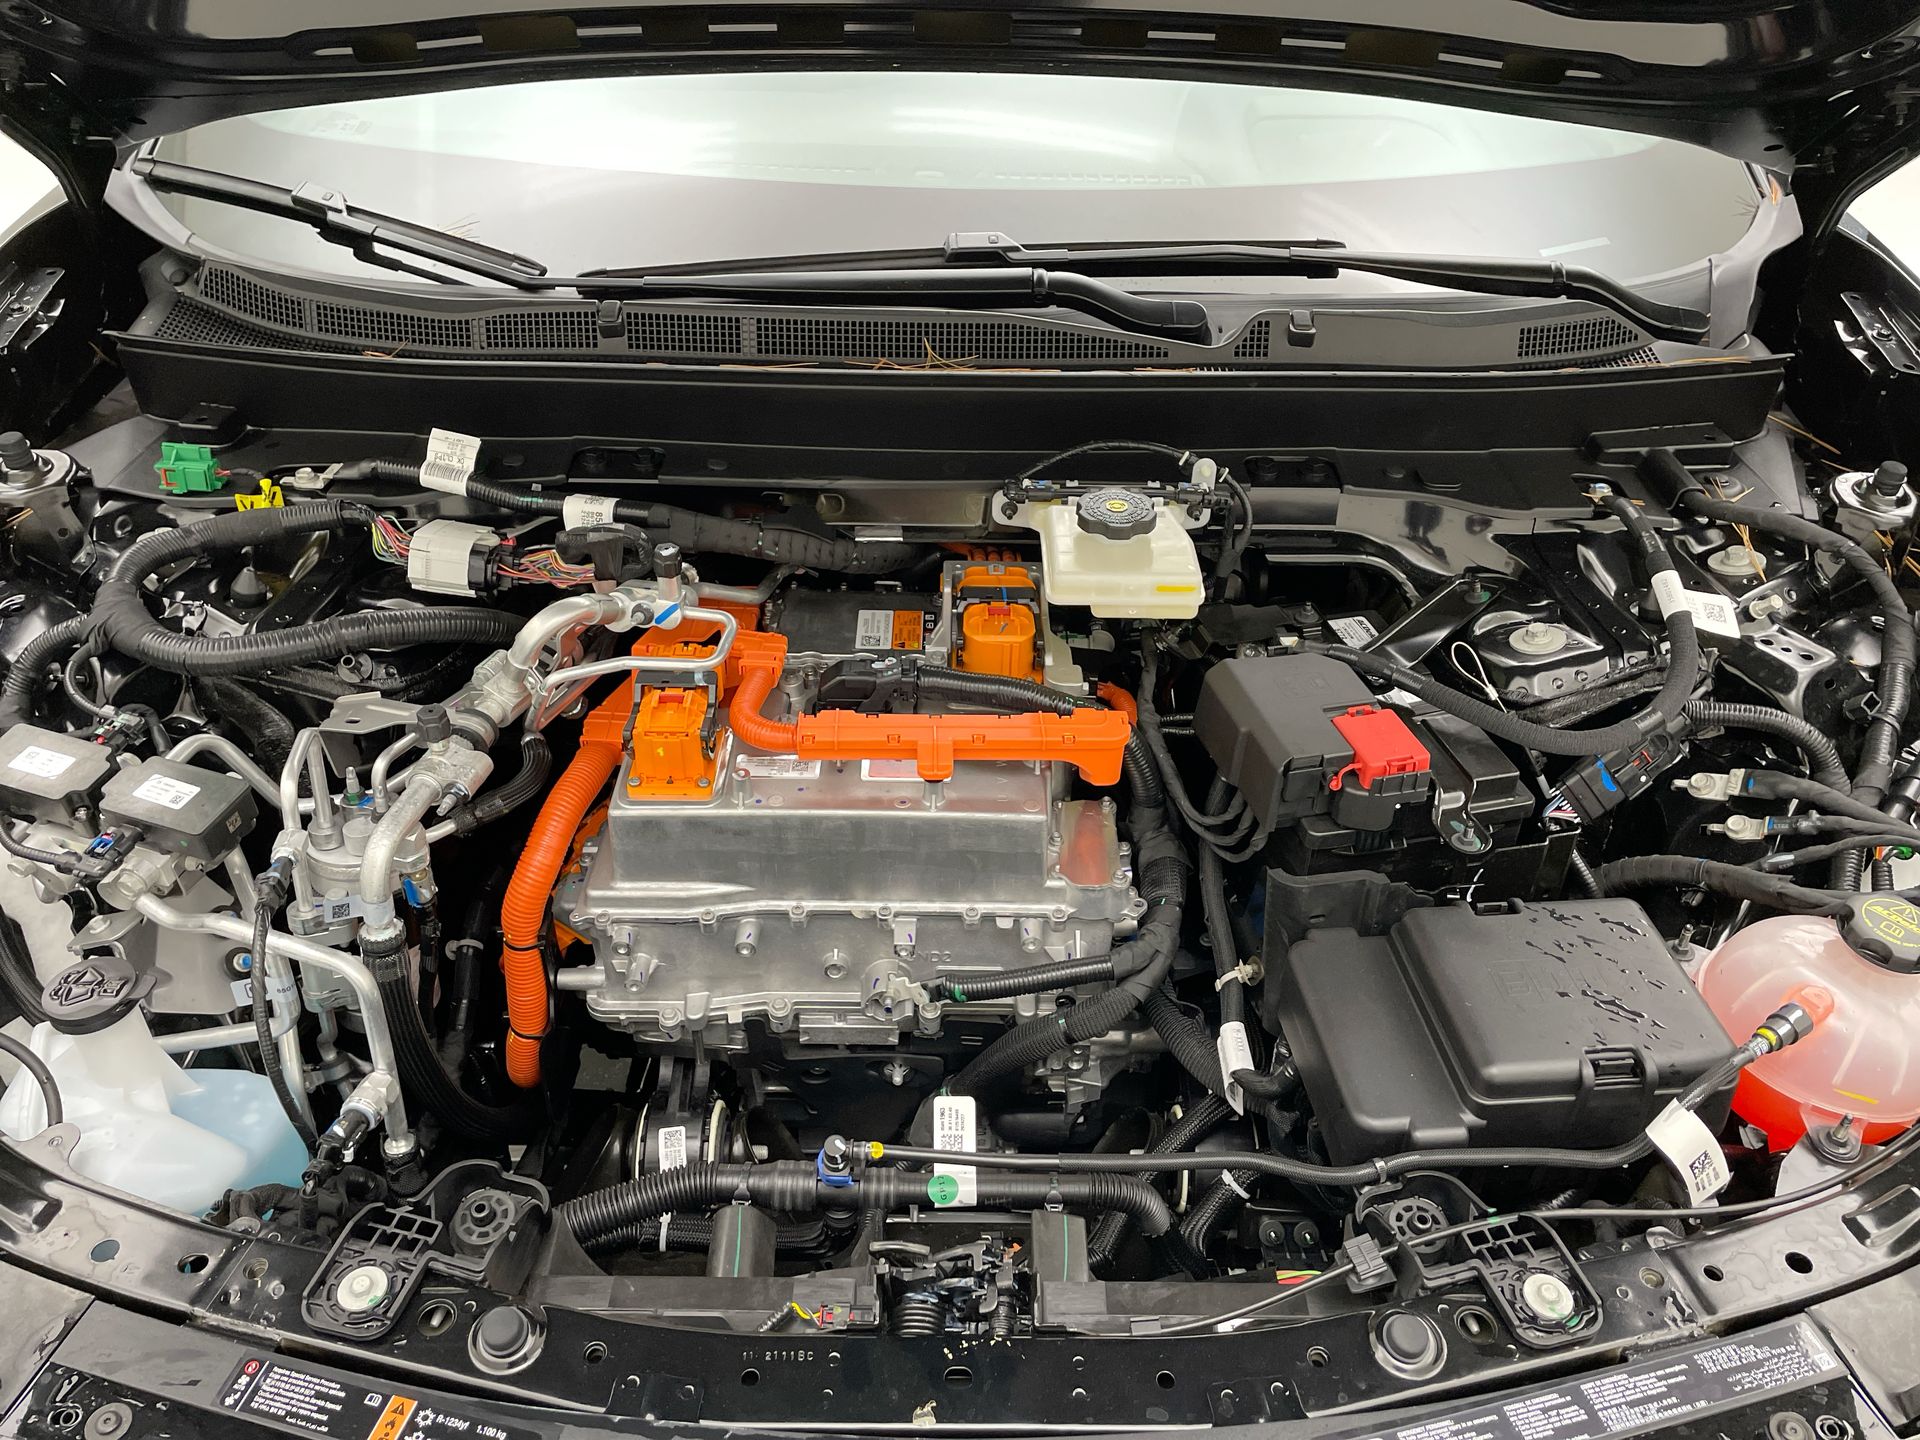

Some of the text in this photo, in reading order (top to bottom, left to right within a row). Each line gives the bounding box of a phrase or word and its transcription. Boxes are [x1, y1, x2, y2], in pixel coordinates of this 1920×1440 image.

[436, 1414, 507, 1440] R-1234yf 1.100 kg
